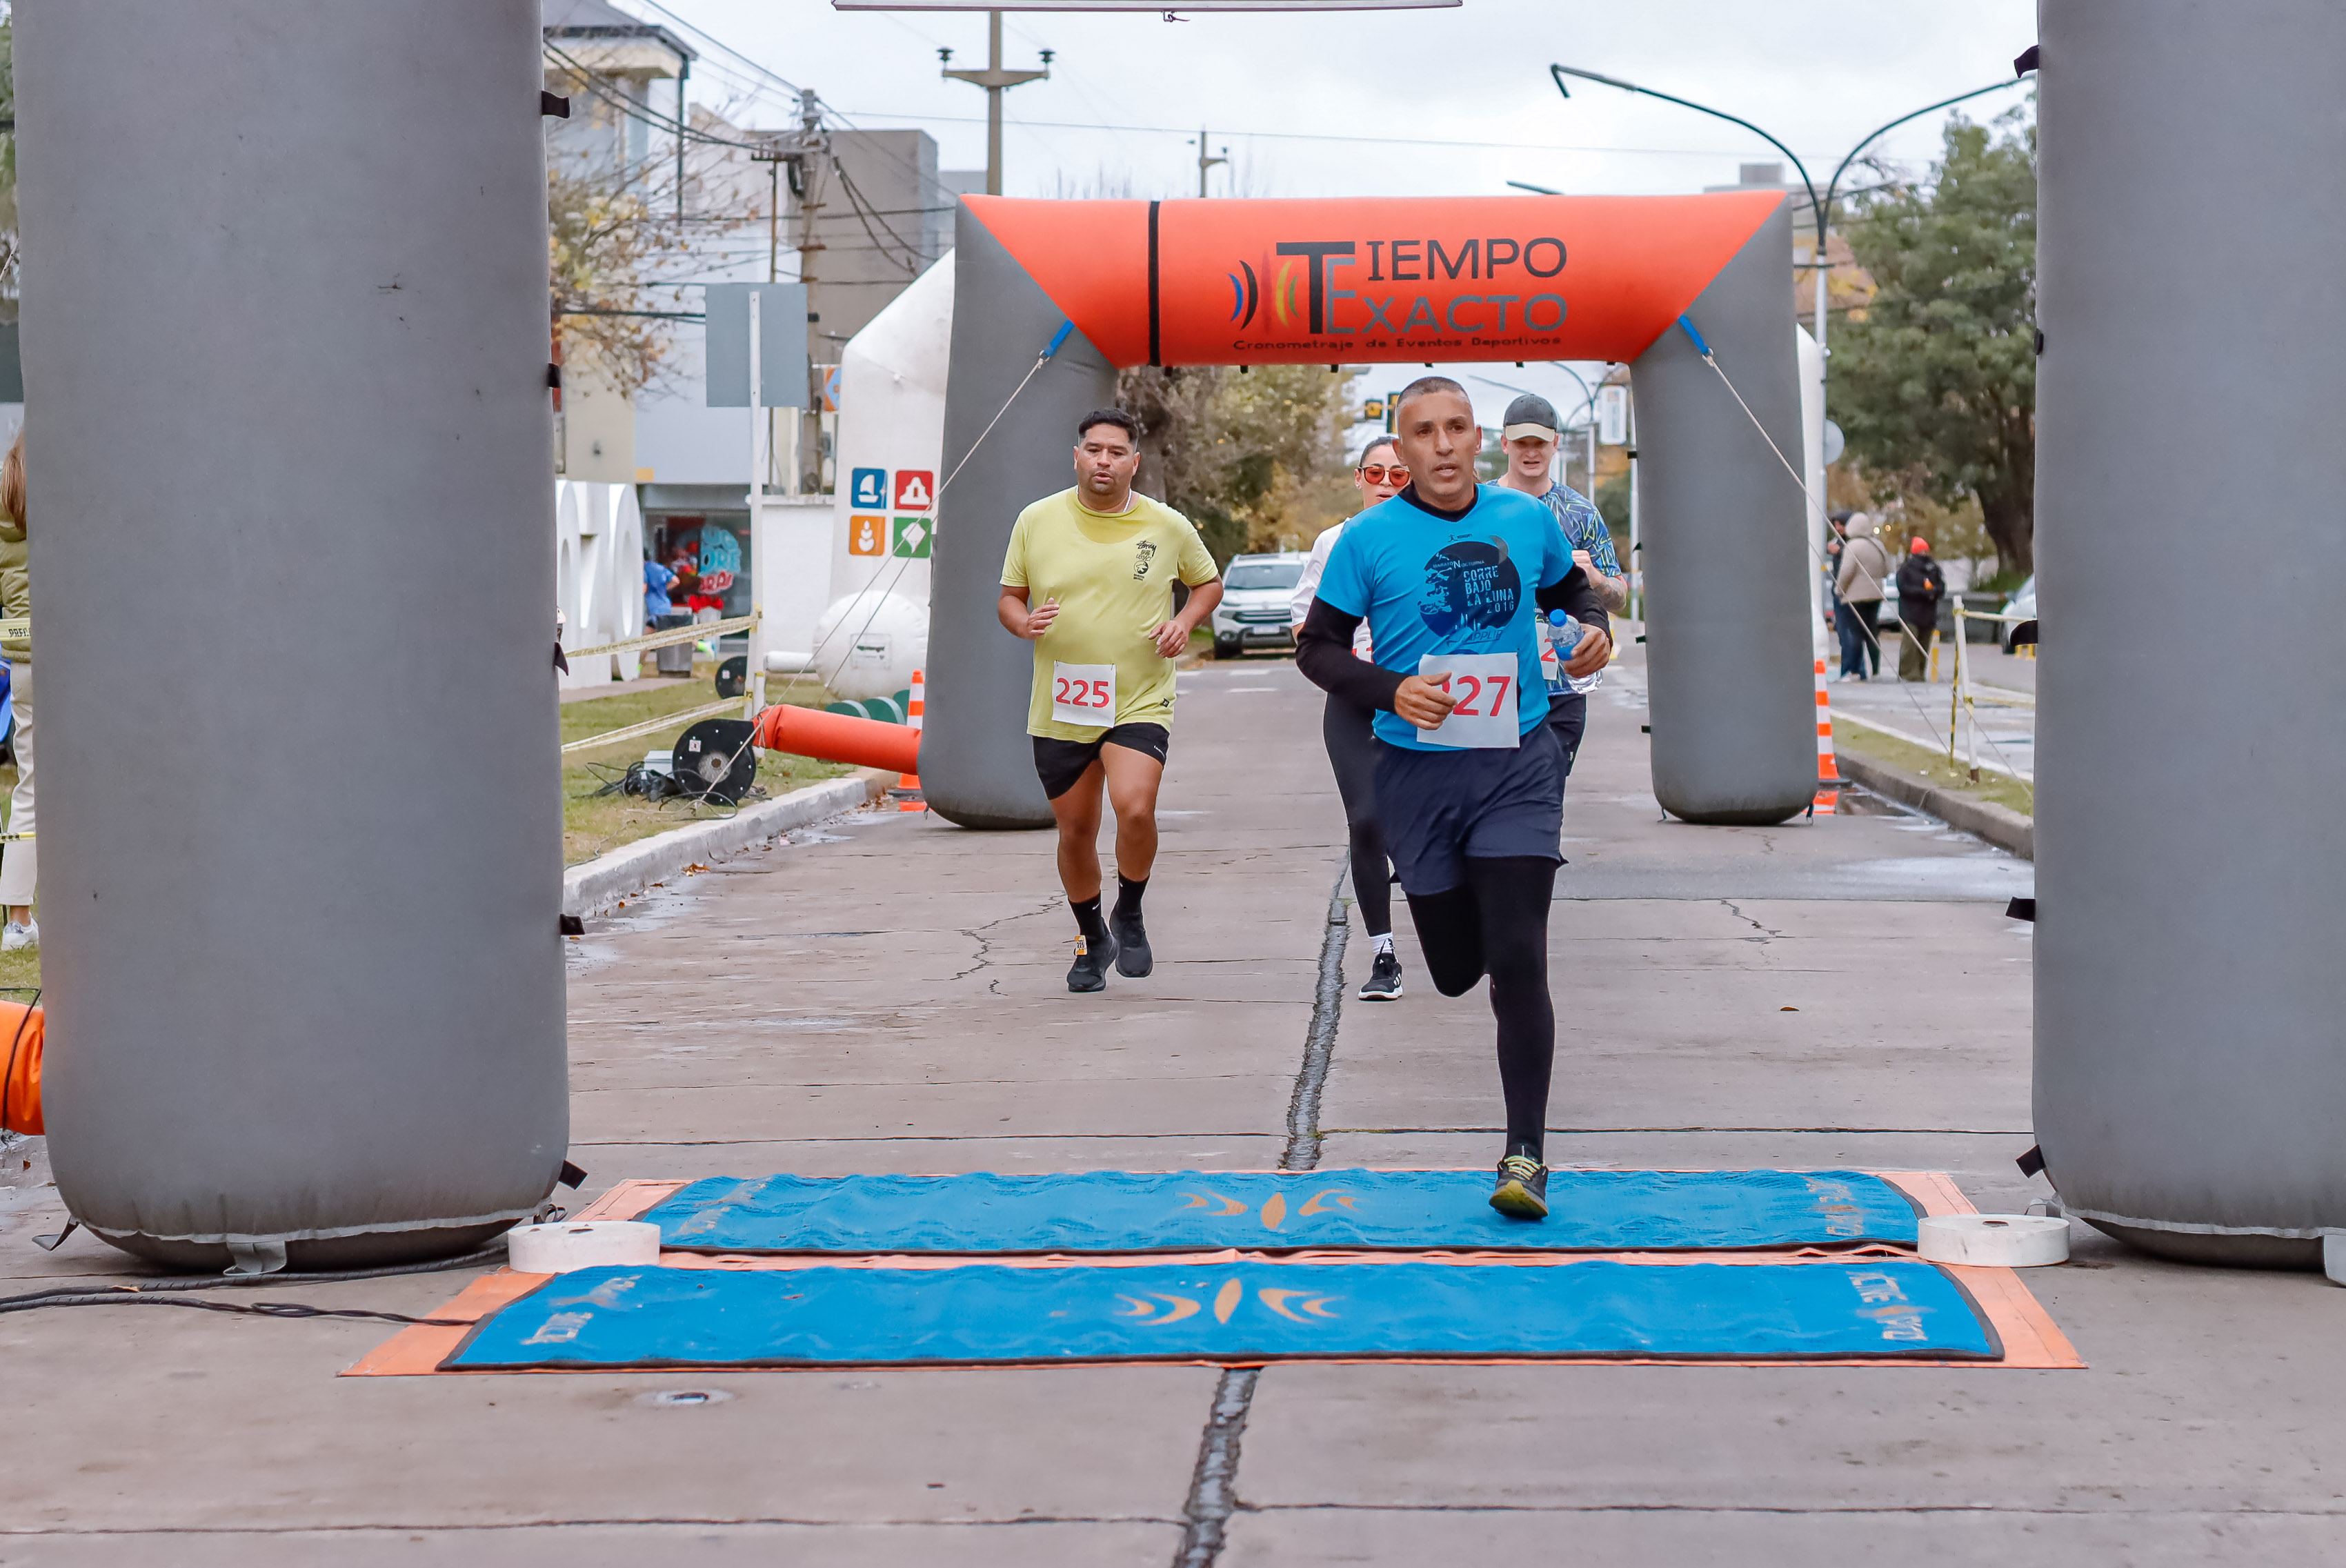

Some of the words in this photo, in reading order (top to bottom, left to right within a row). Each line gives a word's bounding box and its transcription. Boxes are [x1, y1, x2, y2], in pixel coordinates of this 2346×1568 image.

[1276, 237, 1567, 334] TIEMPO
[1326, 257, 1568, 334] EXACTO
[1233, 339, 1354, 351] Cronometraje
[1366, 339, 1386, 348] de
[1396, 338, 1462, 348] Eventos
[1471, 337, 1562, 348] Deportivos
[1463, 566, 1500, 583] CORRE
[1465, 579, 1492, 595] BAJO
[1467, 593, 1482, 606] LA
[1485, 588, 1514, 604] LUNA
[1055, 677, 1110, 708] 225
[1442, 675, 1511, 717] 27
